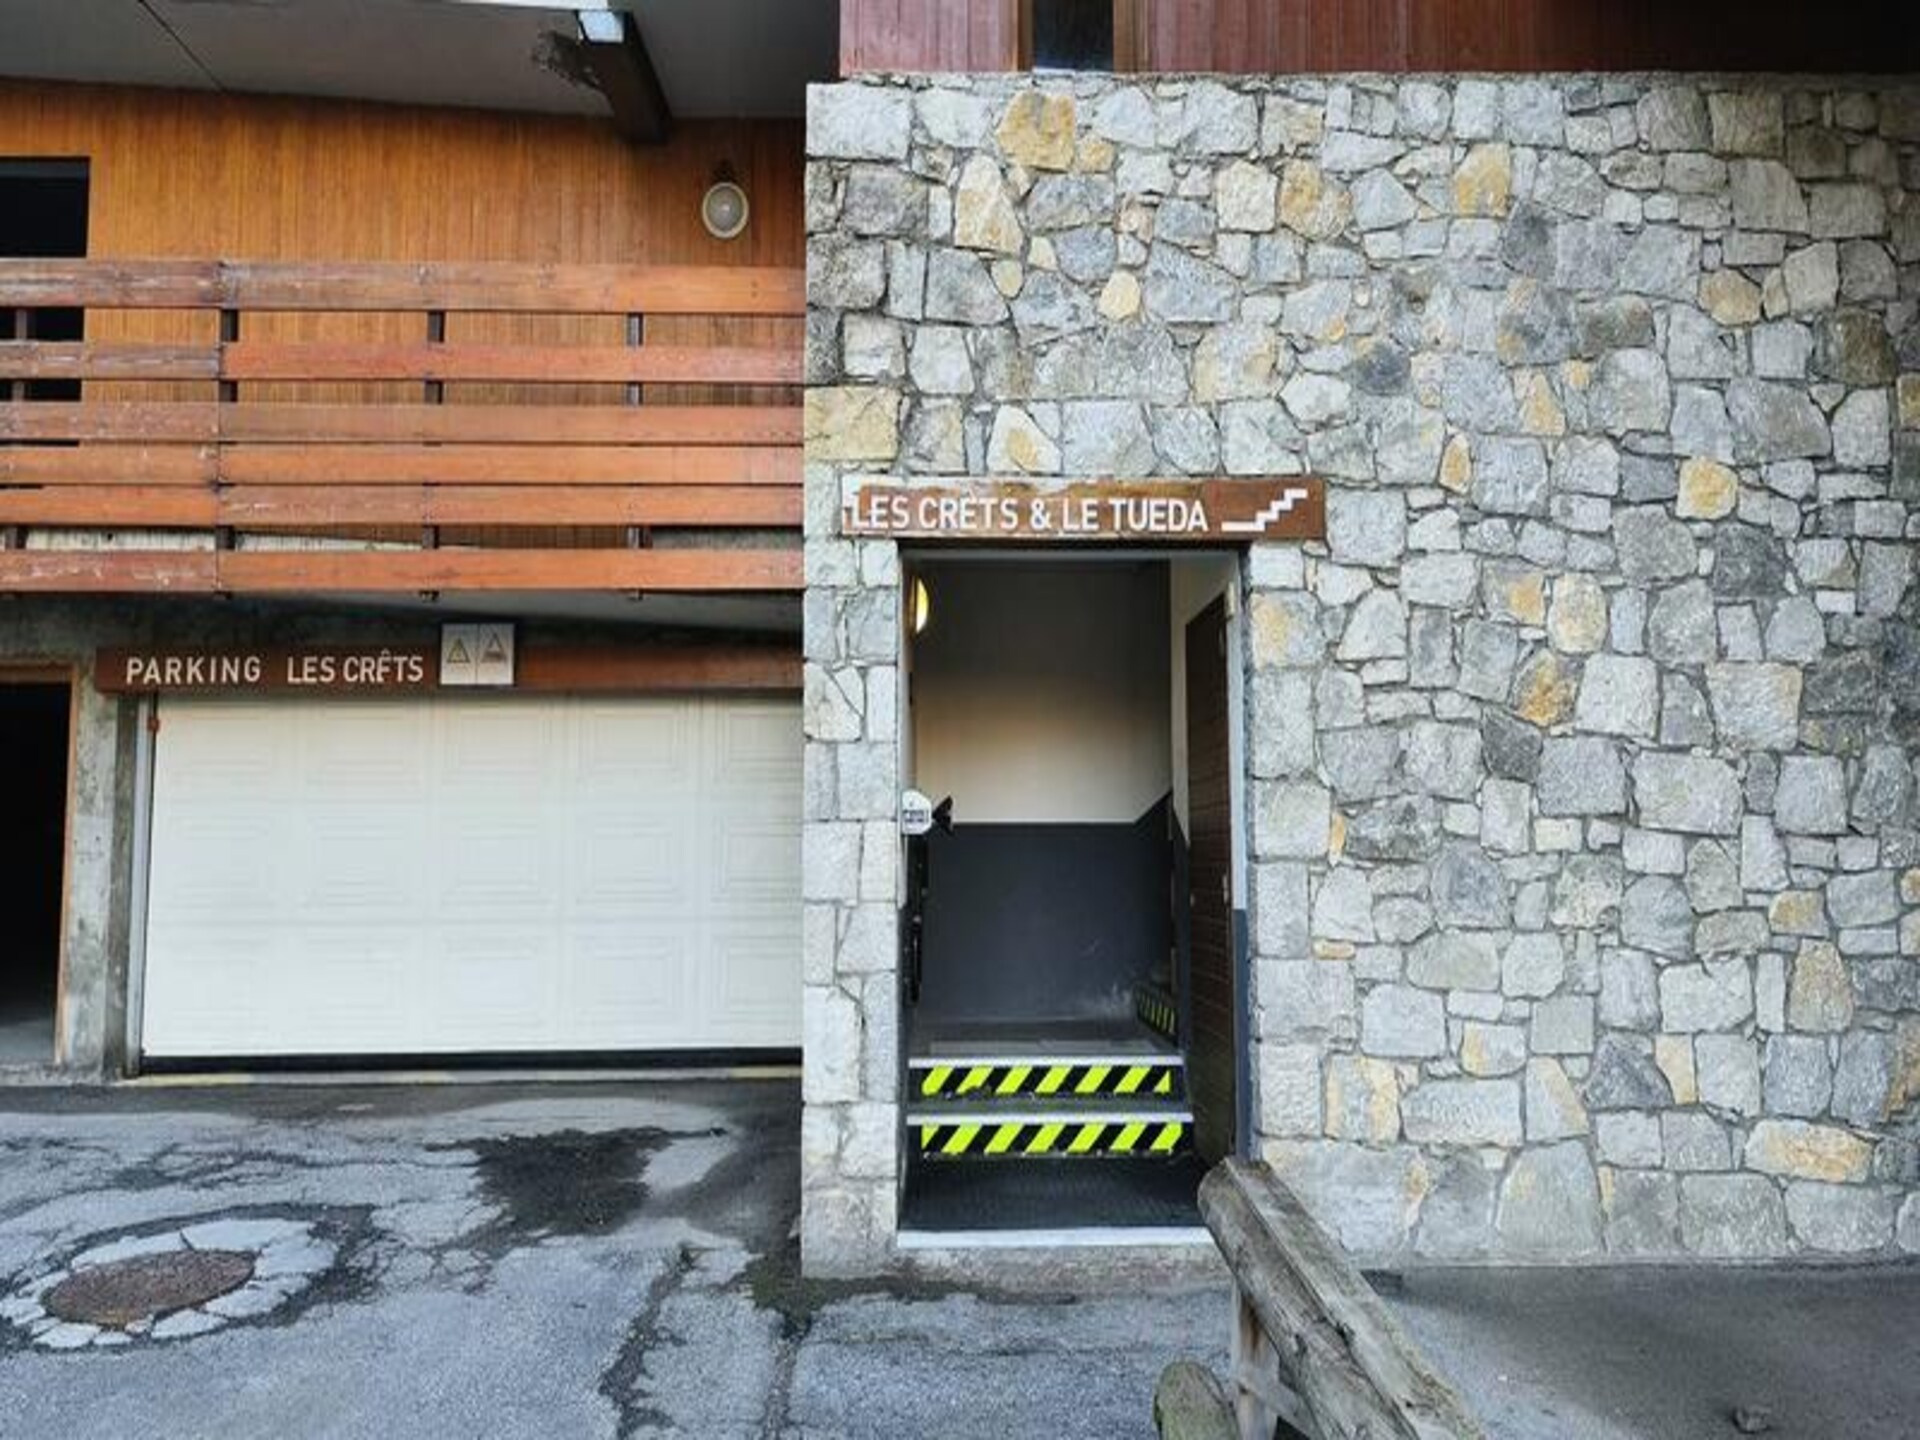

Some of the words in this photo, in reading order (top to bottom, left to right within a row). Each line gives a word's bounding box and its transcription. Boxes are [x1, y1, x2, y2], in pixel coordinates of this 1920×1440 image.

[852, 496, 910, 529] LES
[1030, 498, 1052, 531] &
[1062, 498, 1099, 531] LE
[1108, 498, 1209, 532] TUEDA
[126, 655, 261, 685] PARKING
[287, 656, 336, 684] LES
[343, 648, 424, 683] CRÊTS
